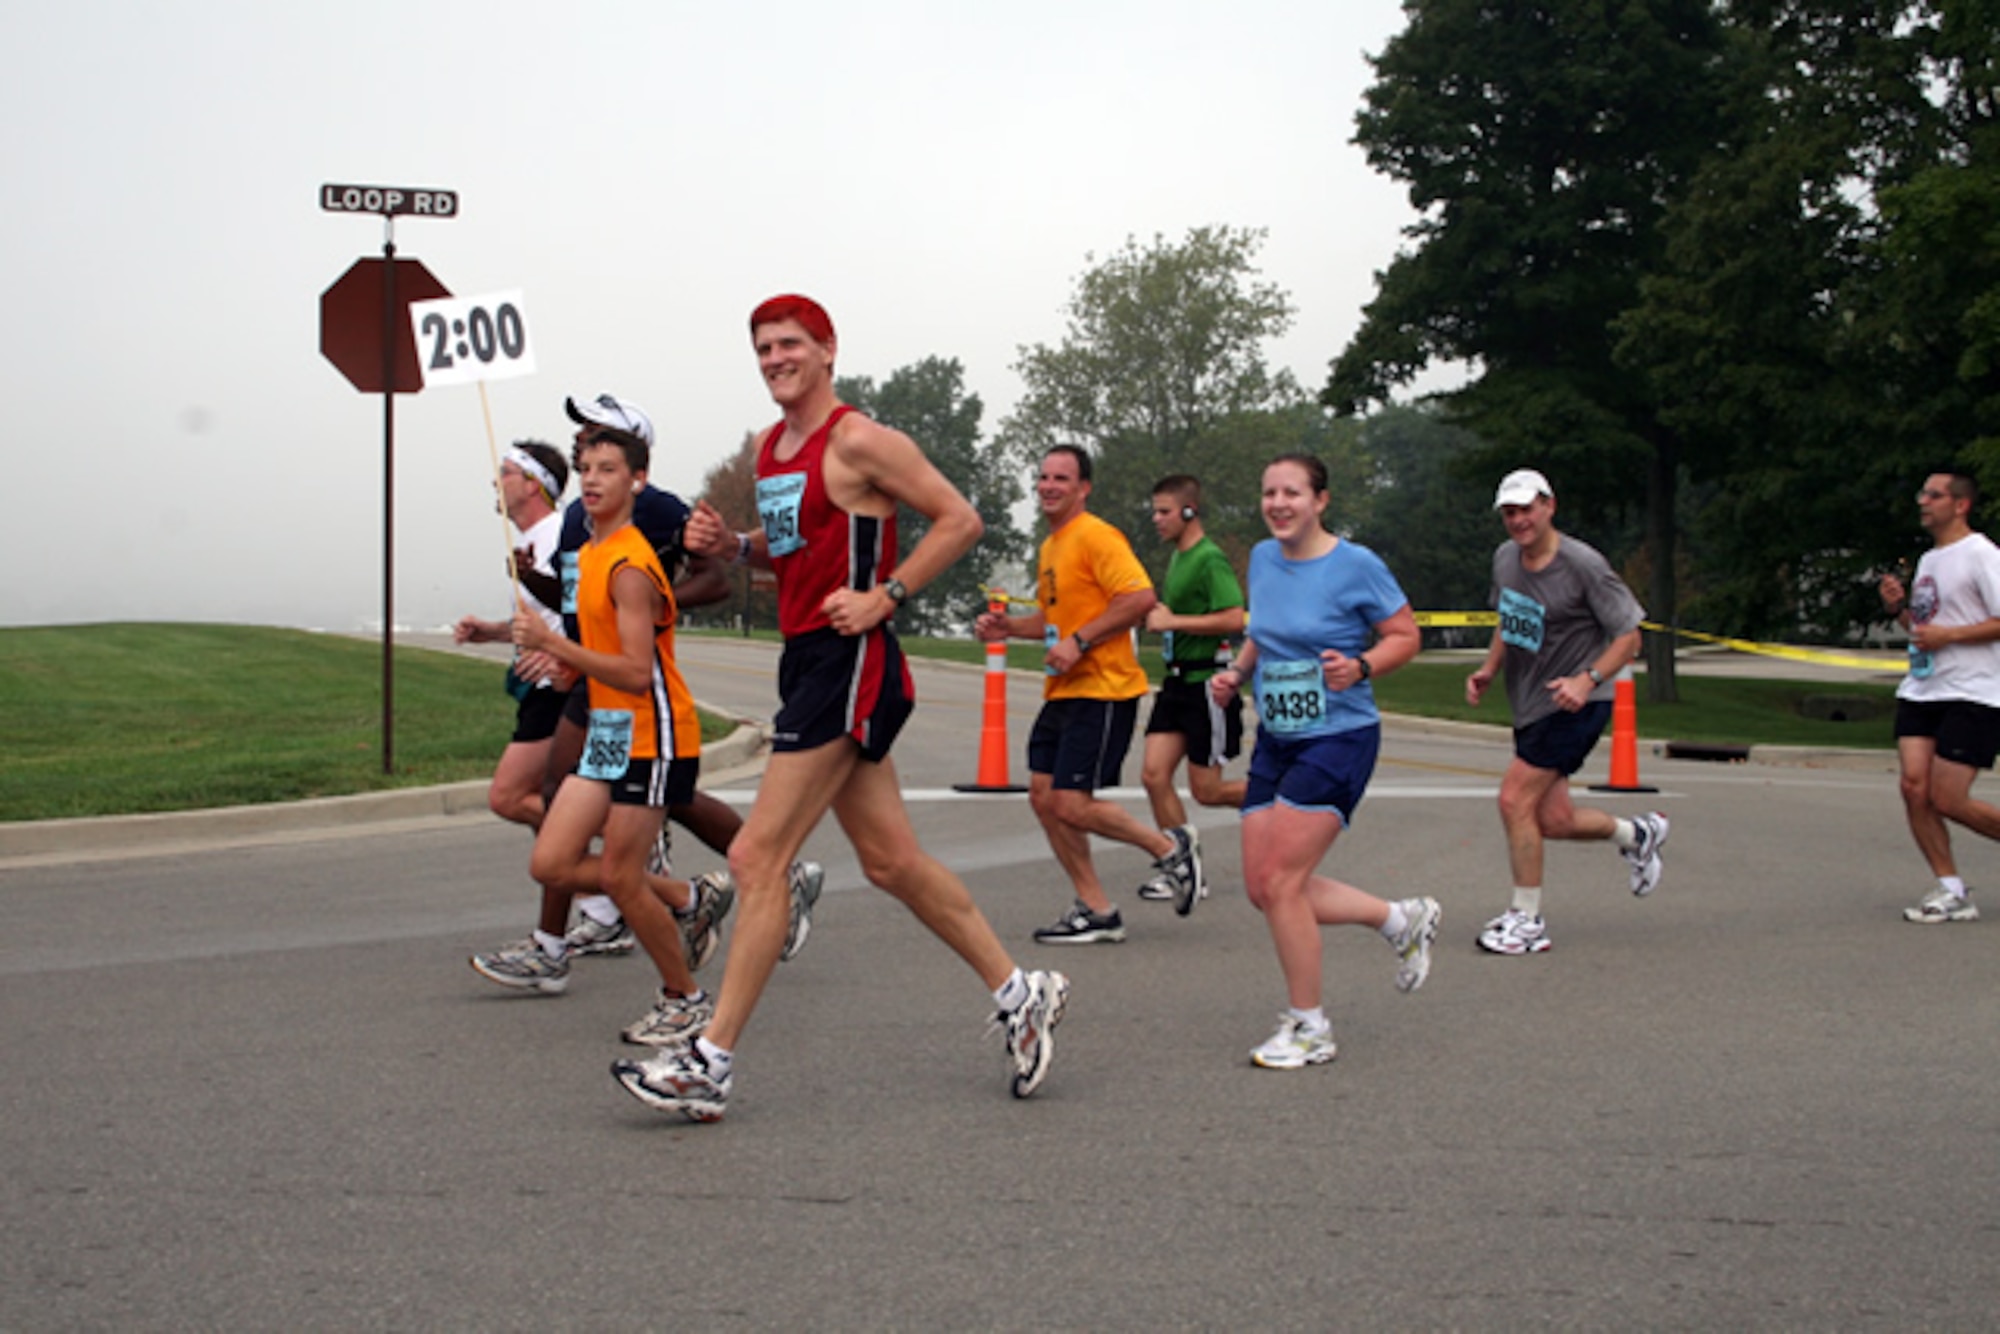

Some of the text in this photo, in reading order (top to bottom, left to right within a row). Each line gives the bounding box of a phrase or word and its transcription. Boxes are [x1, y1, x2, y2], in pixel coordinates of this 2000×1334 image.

[325, 186, 454, 214] LOOP RD
[421, 302, 525, 371] 2:00
[1264, 690, 1319, 721] 3438
